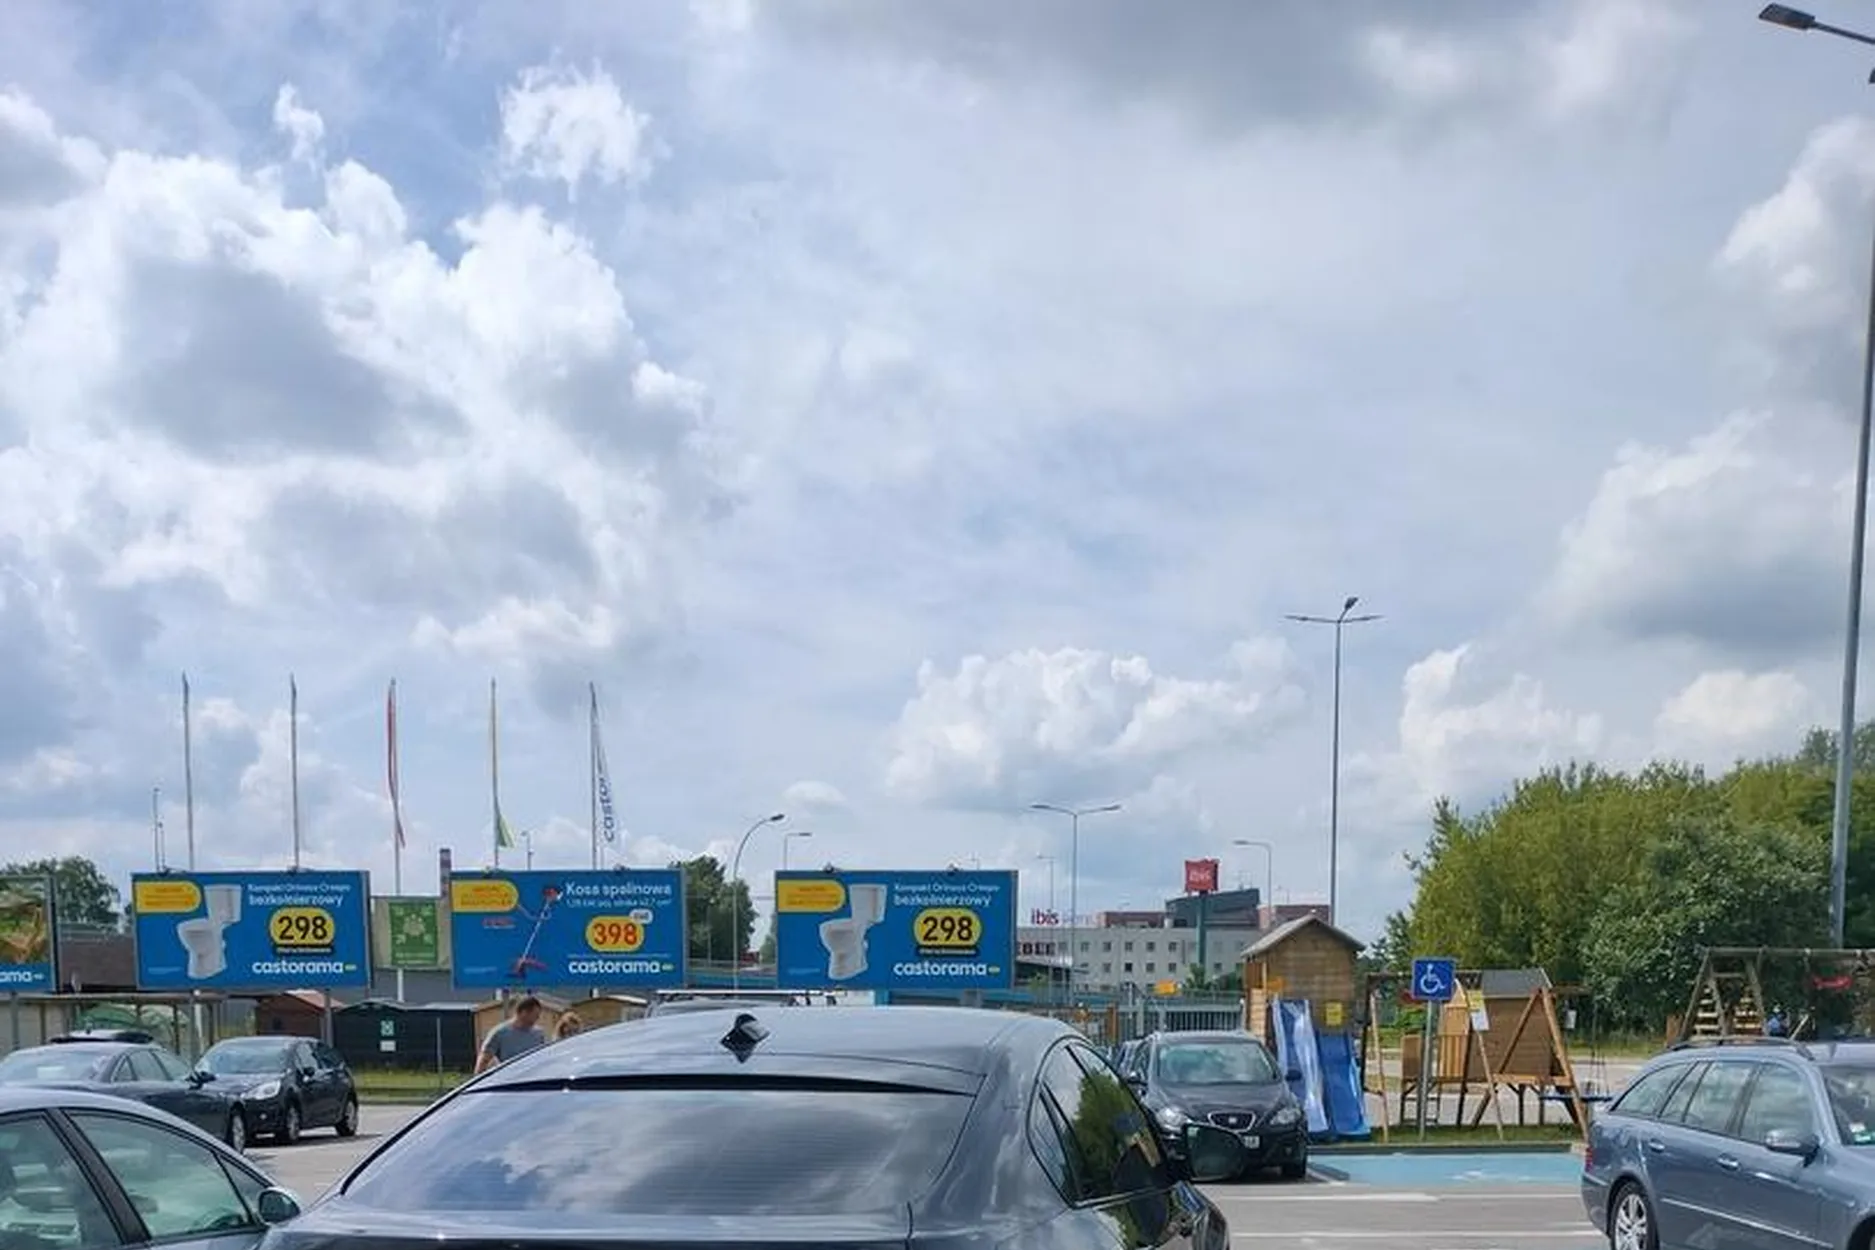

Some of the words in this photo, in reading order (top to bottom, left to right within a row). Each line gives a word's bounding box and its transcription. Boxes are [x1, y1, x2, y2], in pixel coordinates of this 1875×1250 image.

[602, 881, 672, 898] spalinowa
[1031, 908, 1059, 924] ibis
[278, 916, 328, 940] 298
[593, 923, 638, 946] 398
[922, 916, 973, 941] 298
[251, 960, 343, 974] castorama
[568, 960, 660, 974] castorama
[893, 961, 987, 976] castorama
